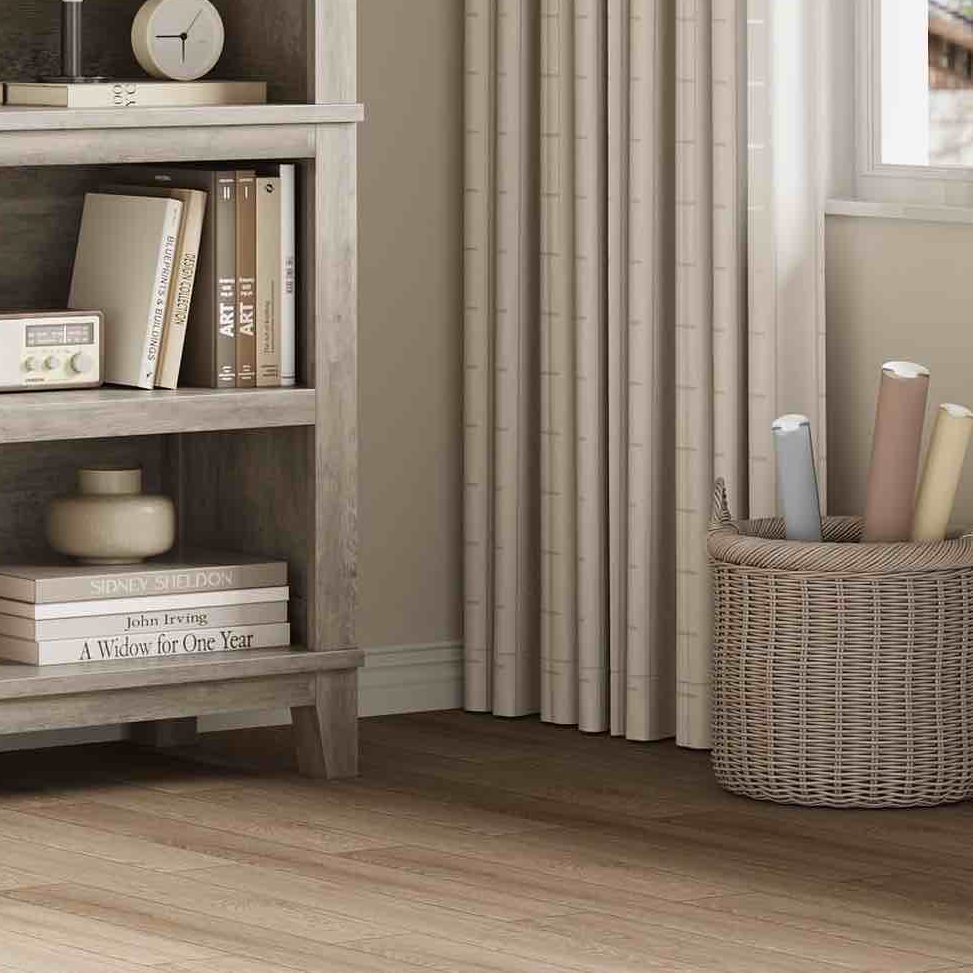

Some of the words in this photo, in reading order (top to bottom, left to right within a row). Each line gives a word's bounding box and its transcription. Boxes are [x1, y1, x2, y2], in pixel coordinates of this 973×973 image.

[157, 235, 174, 298] BLUEPRINTS
[148, 306, 163, 361] BUILDINGS
[219, 303, 235, 337] ART
[240, 302, 254, 336] ART
[90, 577, 148, 594] SIDNEY
[155, 571, 235, 590] SHELDON
[125, 614, 159, 631] John
[164, 612, 208, 627] Irving
[79, 643, 91, 661] A
[99, 638, 152, 659] Widow
[157, 633, 179, 654] for
[183, 633, 216, 652] One
[221, 630, 254, 649] Year
